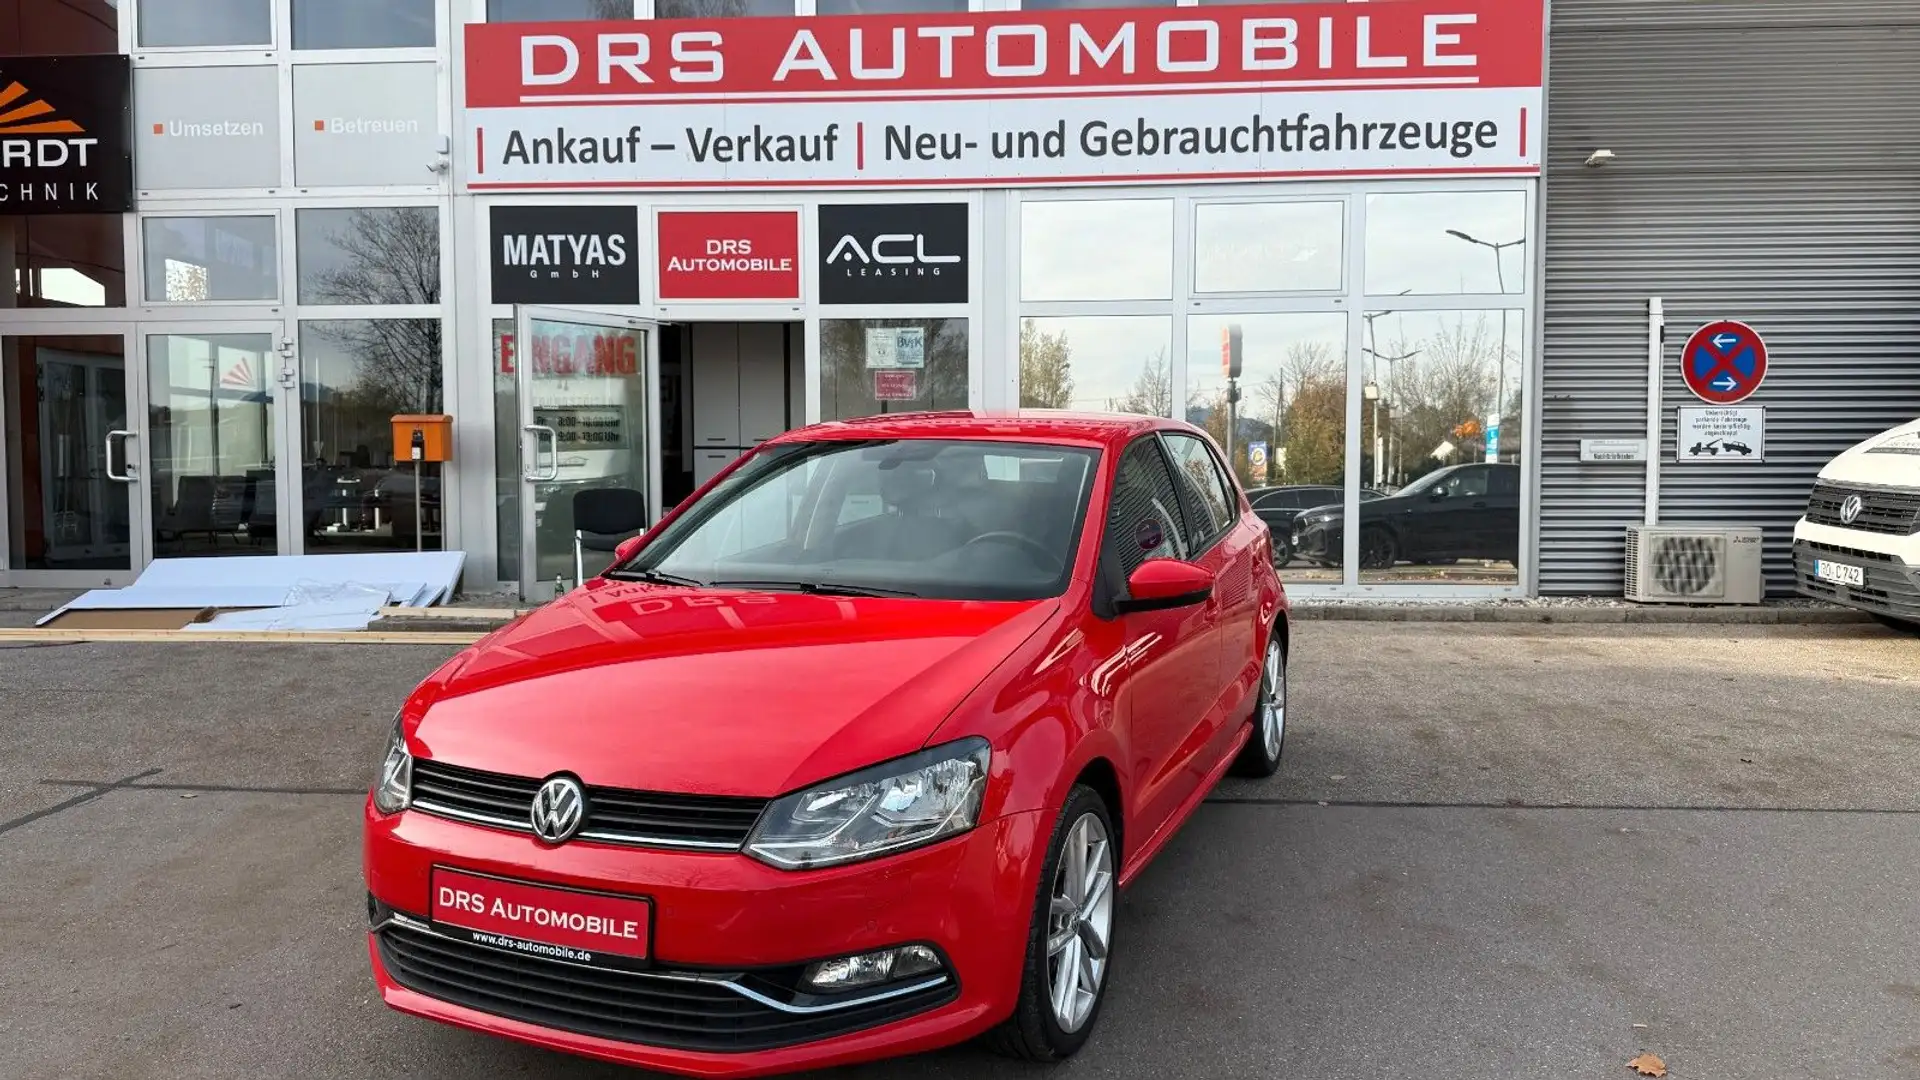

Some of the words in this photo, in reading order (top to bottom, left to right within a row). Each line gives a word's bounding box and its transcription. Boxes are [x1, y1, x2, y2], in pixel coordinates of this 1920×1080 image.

[520, 31, 724, 86] DRS
[772, 13, 1478, 81] AUTOMOBILE
[169, 120, 264, 136] Umsetzen
[330, 117, 418, 134] Betreuen
[502, 126, 641, 165] Ankauf
[686, 124, 839, 163] Verkauf
[884, 125, 978, 161] Neu-
[992, 119, 1066, 159] und
[1079, 111, 1498, 158] Gebrauchtfahrzeuge
[2, 138, 99, 168] RDT
[503, 234, 627, 265] MATYAS
[706, 239, 752, 255] DRS
[825, 234, 961, 263] ACL
[846, 267, 941, 277] LEASING
[500, 334, 636, 376] ENGANG
[438, 887, 485, 914] DRS
[472, 931, 592, 962] www.drs-automobile.de
